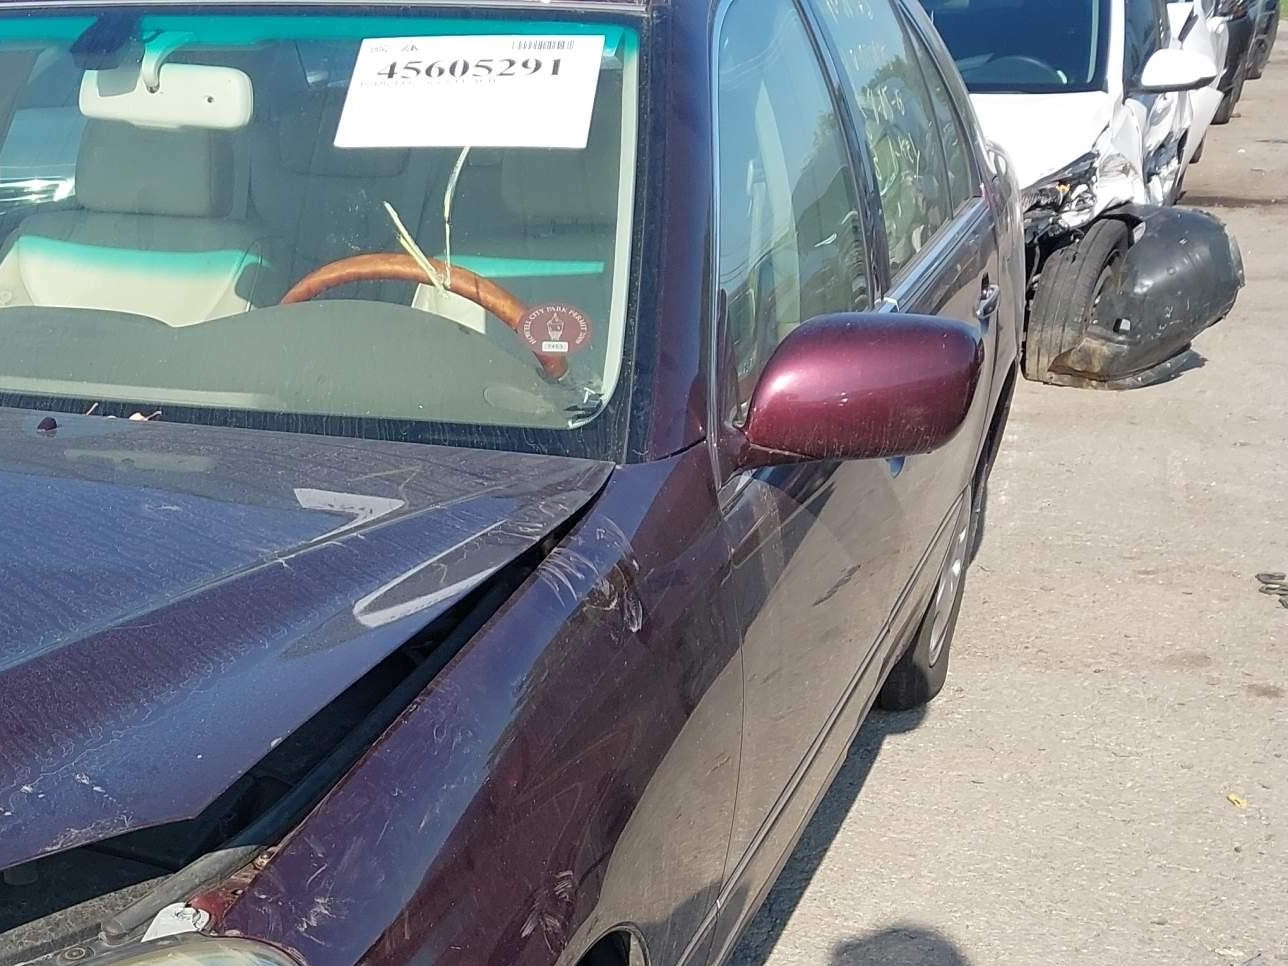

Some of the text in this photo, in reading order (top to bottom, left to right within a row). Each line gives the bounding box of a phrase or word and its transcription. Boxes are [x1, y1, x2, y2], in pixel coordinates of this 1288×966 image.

[377, 58, 562, 79] 45605291
[529, 308, 545, 320] CITY
[568, 309, 588, 331] PERMIT
